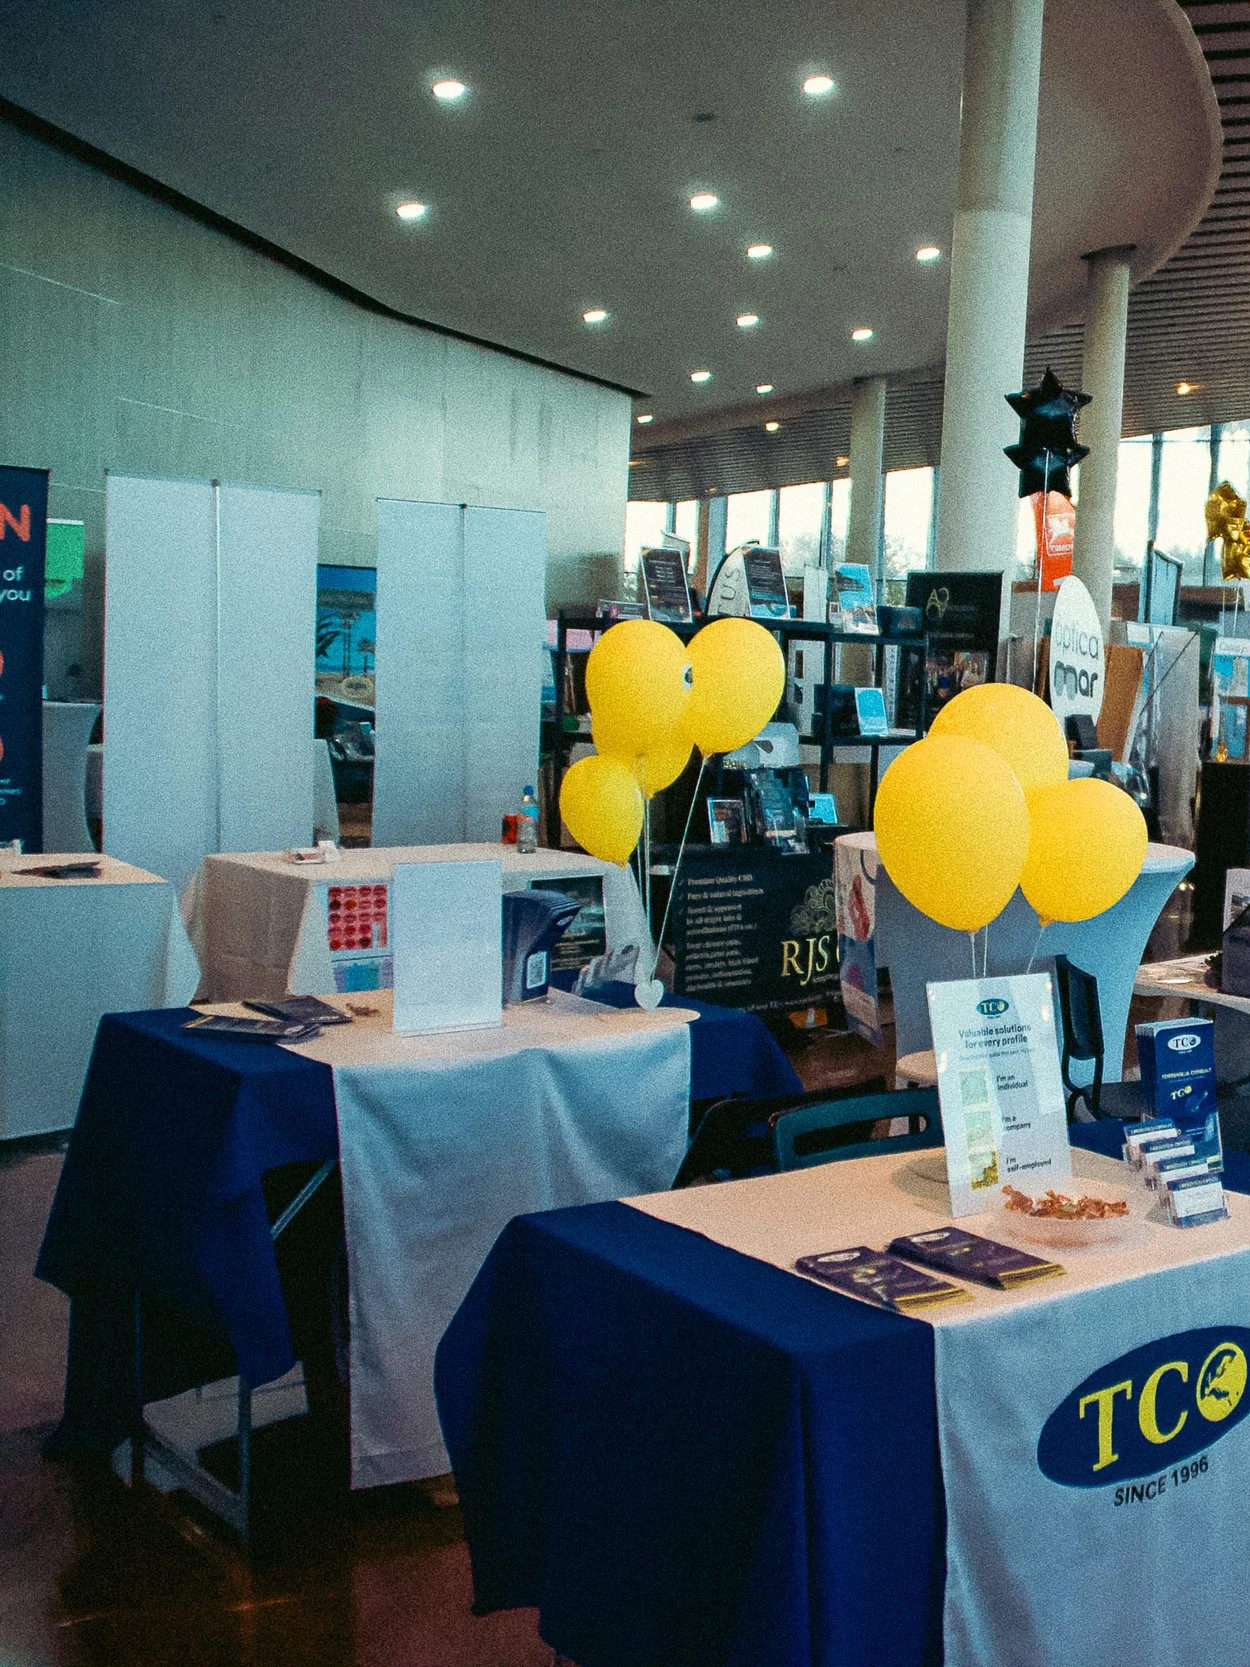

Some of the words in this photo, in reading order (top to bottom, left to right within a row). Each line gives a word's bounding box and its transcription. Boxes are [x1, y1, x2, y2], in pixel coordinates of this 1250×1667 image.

[2, 566, 23, 581] of
[1055, 620, 1099, 659] optica
[1054, 660, 1099, 700] mar
[780, 935, 831, 986] RJS
[959, 1026, 994, 1040] Valuable
[995, 1024, 1031, 1036] solutions
[965, 1038, 978, 1049] for
[979, 1036, 1001, 1050] every
[1002, 1033, 1028, 1047] profile
[997, 1080, 1029, 1091] individual
[1007, 1158, 1052, 1174] self-employed
[1114, 1474, 1167, 1507] SINCE
[1170, 1455, 1210, 1488] 1996
